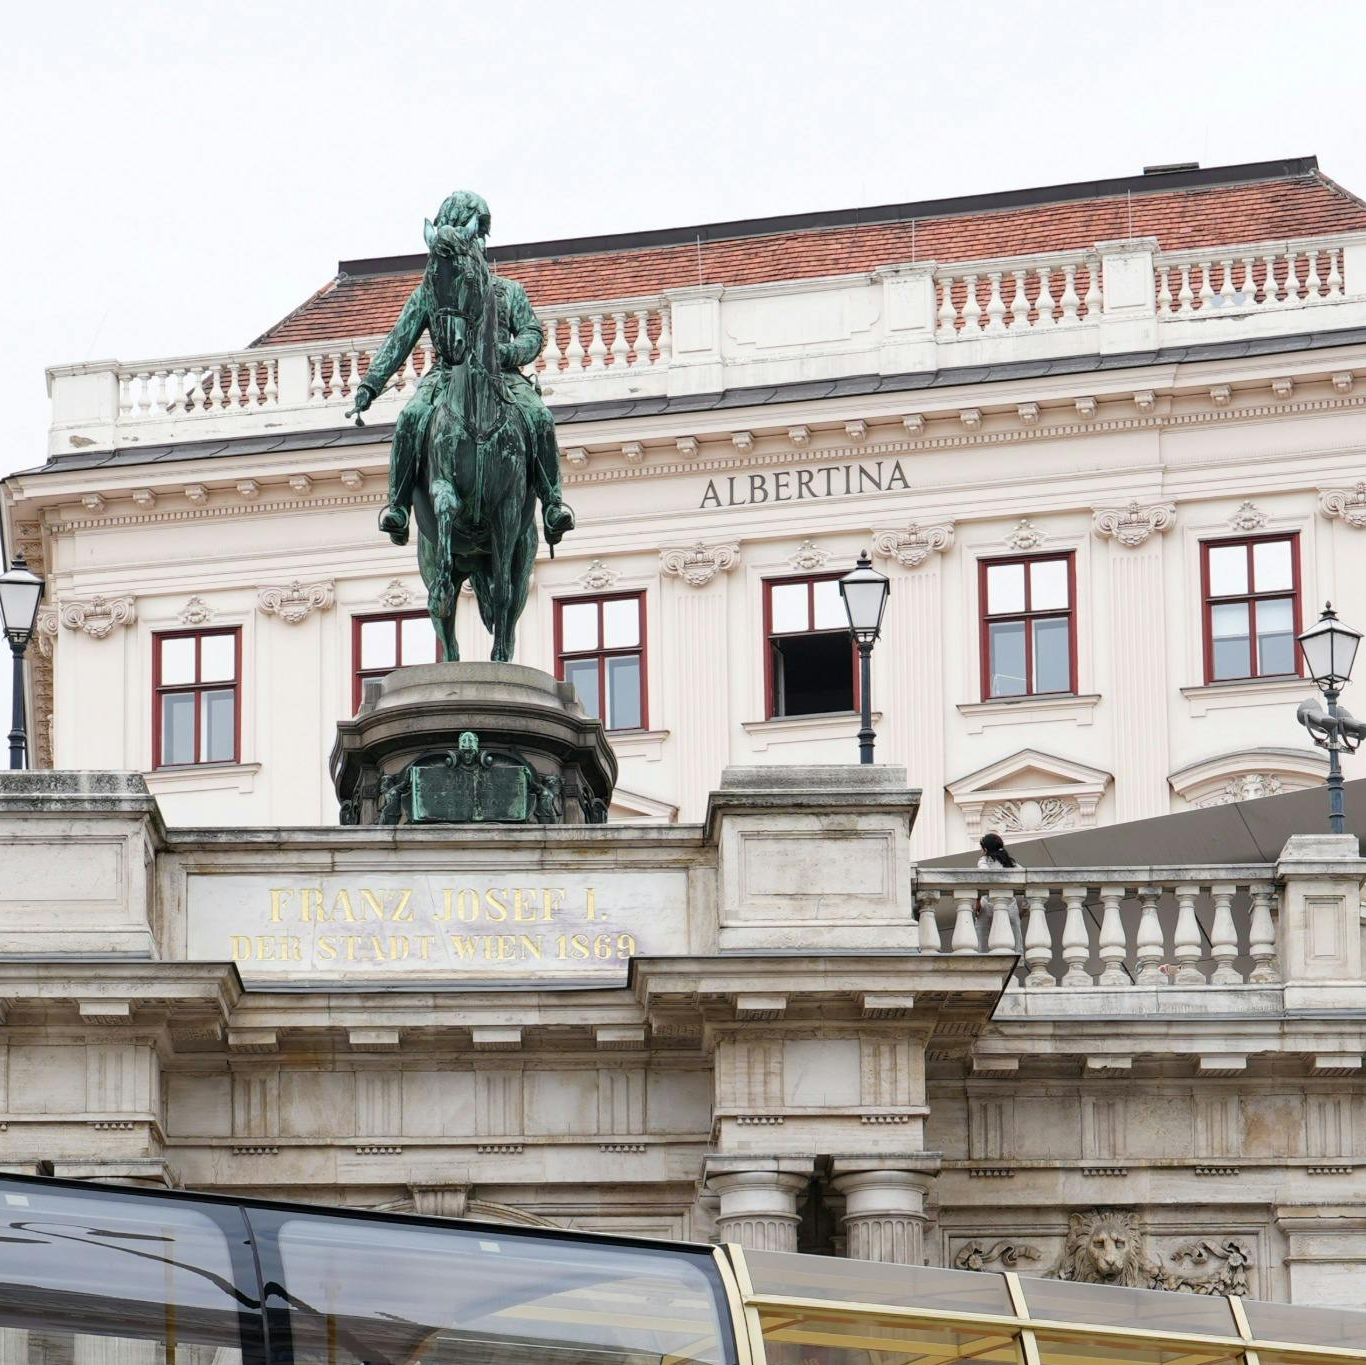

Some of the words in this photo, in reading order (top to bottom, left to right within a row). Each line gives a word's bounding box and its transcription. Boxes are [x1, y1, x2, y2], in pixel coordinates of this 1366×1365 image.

[699, 459, 911, 509] ALBERTINA
[268, 887, 415, 923] FRANZ
[433, 887, 567, 923] JOSEF
[585, 886, 609, 923] I.
[230, 934, 303, 962] DER
[317, 934, 436, 962] STADT
[450, 933, 543, 962] WIEN
[555, 932, 638, 961] 1869
